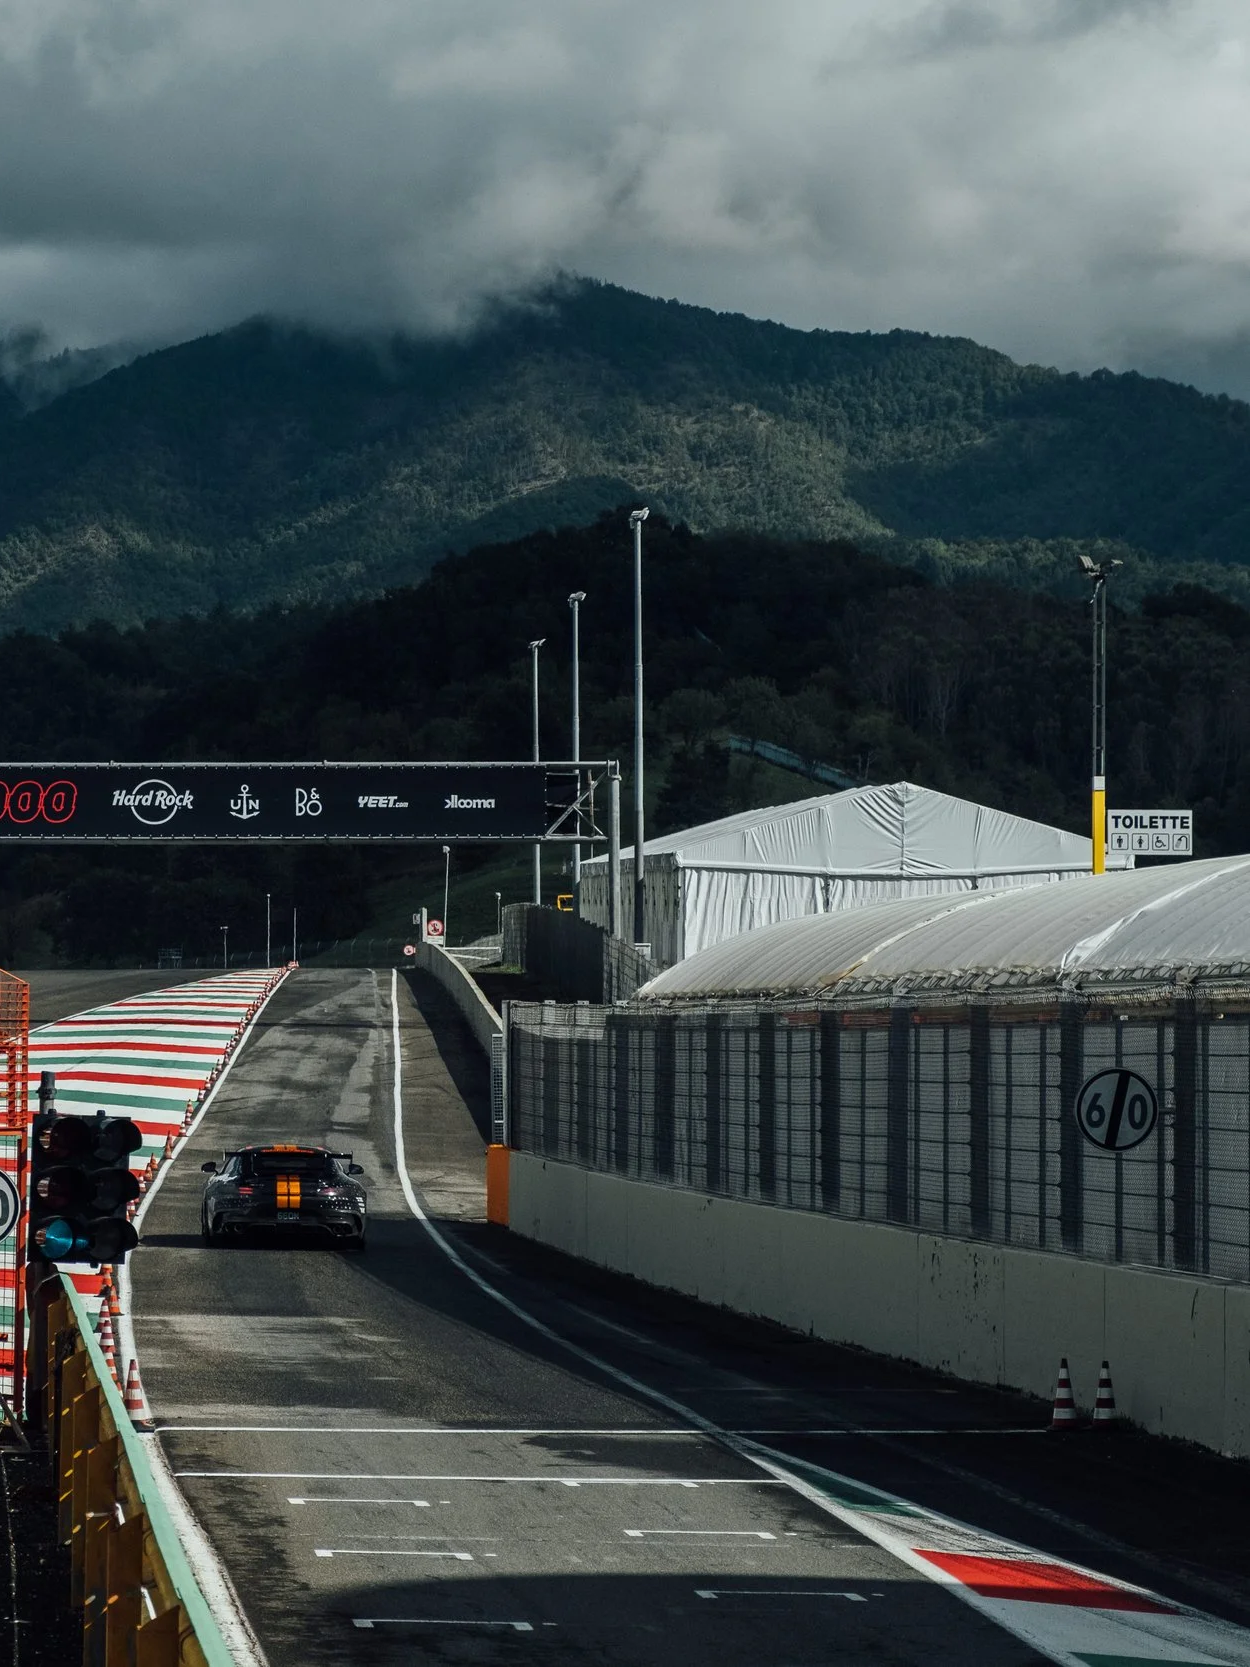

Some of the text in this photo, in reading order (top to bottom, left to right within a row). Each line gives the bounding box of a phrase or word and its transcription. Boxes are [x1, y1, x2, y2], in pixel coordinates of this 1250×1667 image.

[112, 790, 194, 810] Hard Rock
[358, 796, 409, 808] YEET.com
[1111, 815, 1190, 829] TOILETTE
